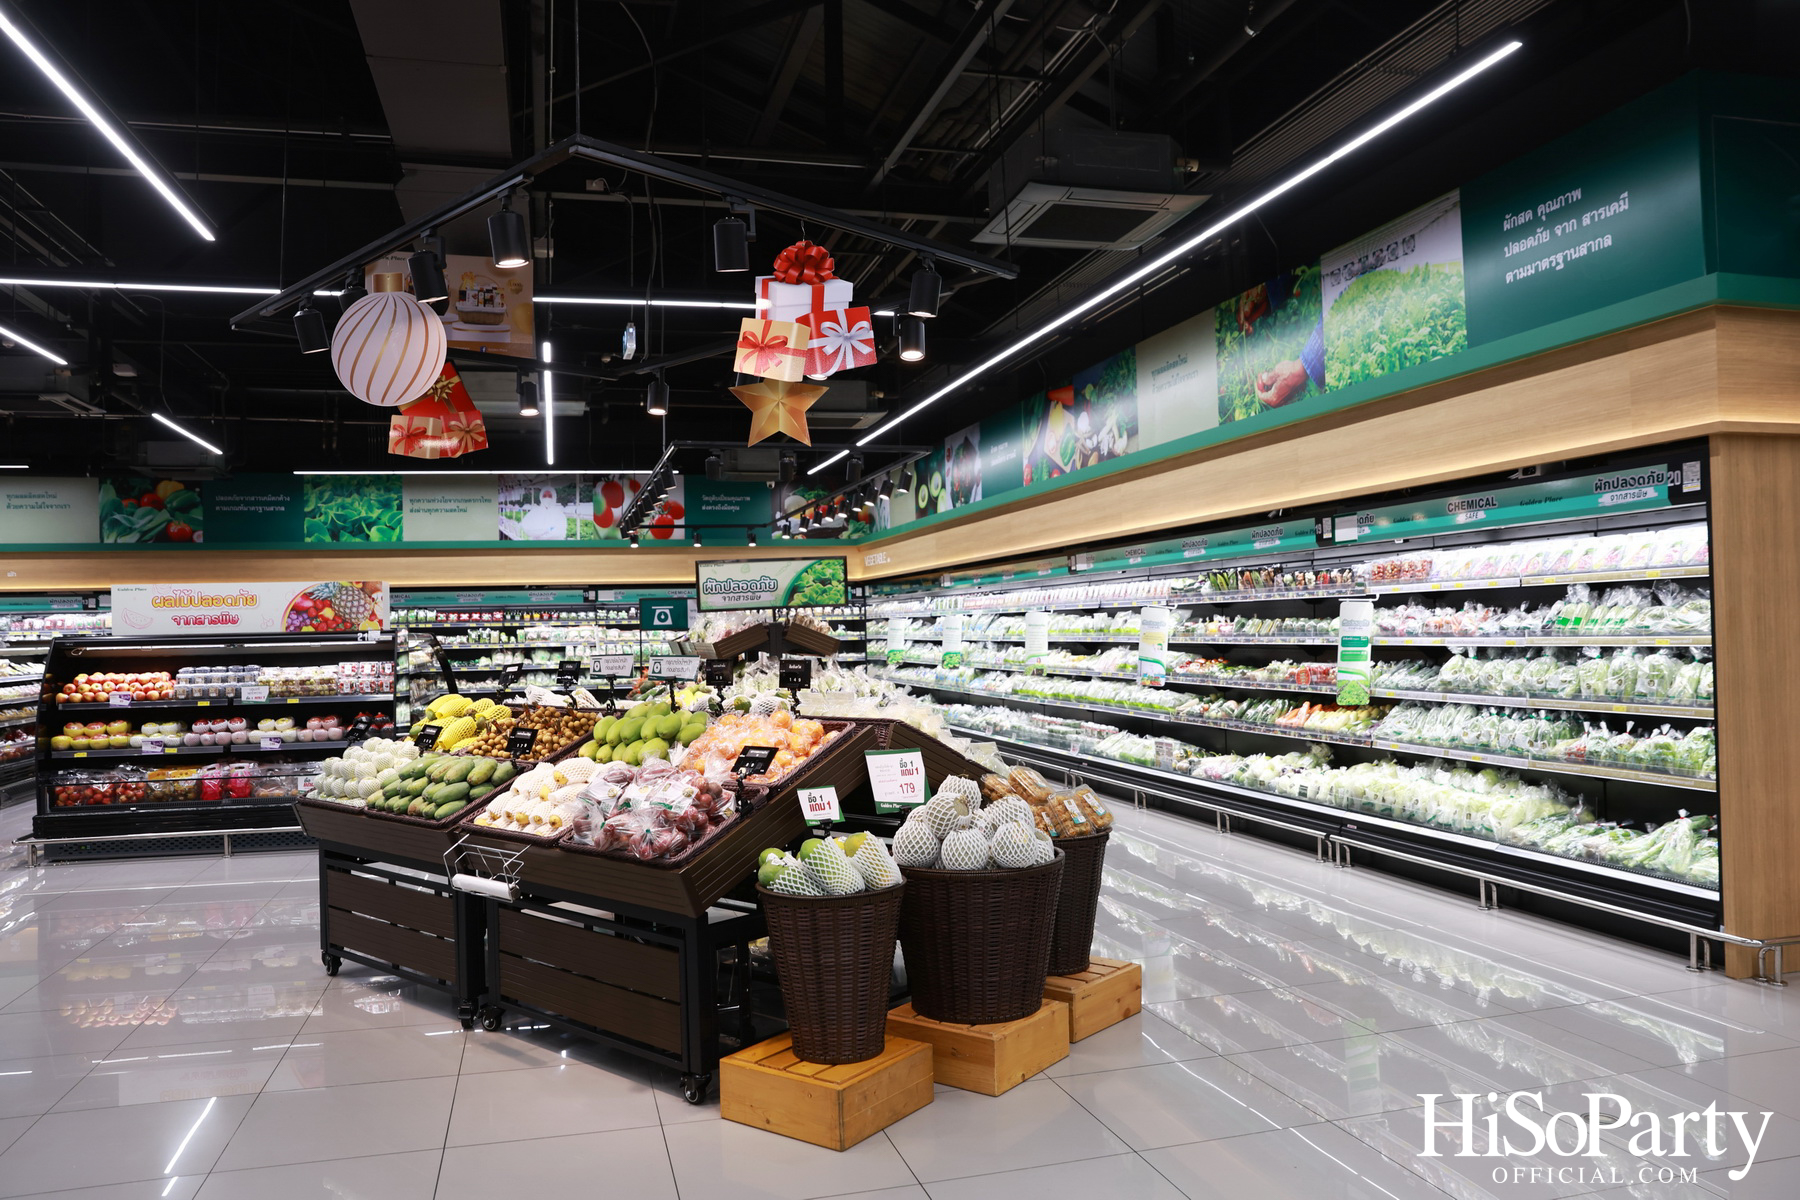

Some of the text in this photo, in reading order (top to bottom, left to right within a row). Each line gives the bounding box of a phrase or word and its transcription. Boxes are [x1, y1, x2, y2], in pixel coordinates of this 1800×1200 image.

[1503, 187, 1582, 232] ผักสด คุณภาพ
[1503, 191, 1629, 258] ปลอดภัย จาก สารเคมี
[1505, 234, 1613, 284] ตามมาตรฐานสากล
[1594, 470, 1665, 492] ผักปลอดภัย
[1667, 470, 1681, 487] 20
[1610, 490, 1648, 502] จากสารพิษ
[1447, 495, 1497, 513] CHEMICAL
[1464, 512, 1479, 520] SAFE
[1251, 526, 1284, 539] ผักปลอดภัย
[1124, 547, 1147, 557] CHEMICAL
[703, 575, 778, 595] ผักปลอดภัย
[151, 588, 258, 608] ผลไม้ปลอดภัย
[721, 592, 762, 602] จากสารพิษ
[171, 611, 240, 626] จากสารพิษ
[899, 757, 914, 769] ซื้อ 1
[900, 768, 915, 777] แถม
[914, 767, 919, 775] 1
[899, 782, 916, 794] 179
[807, 791, 824, 804] ซื้อ 1
[809, 800, 832, 812] แถม 1
